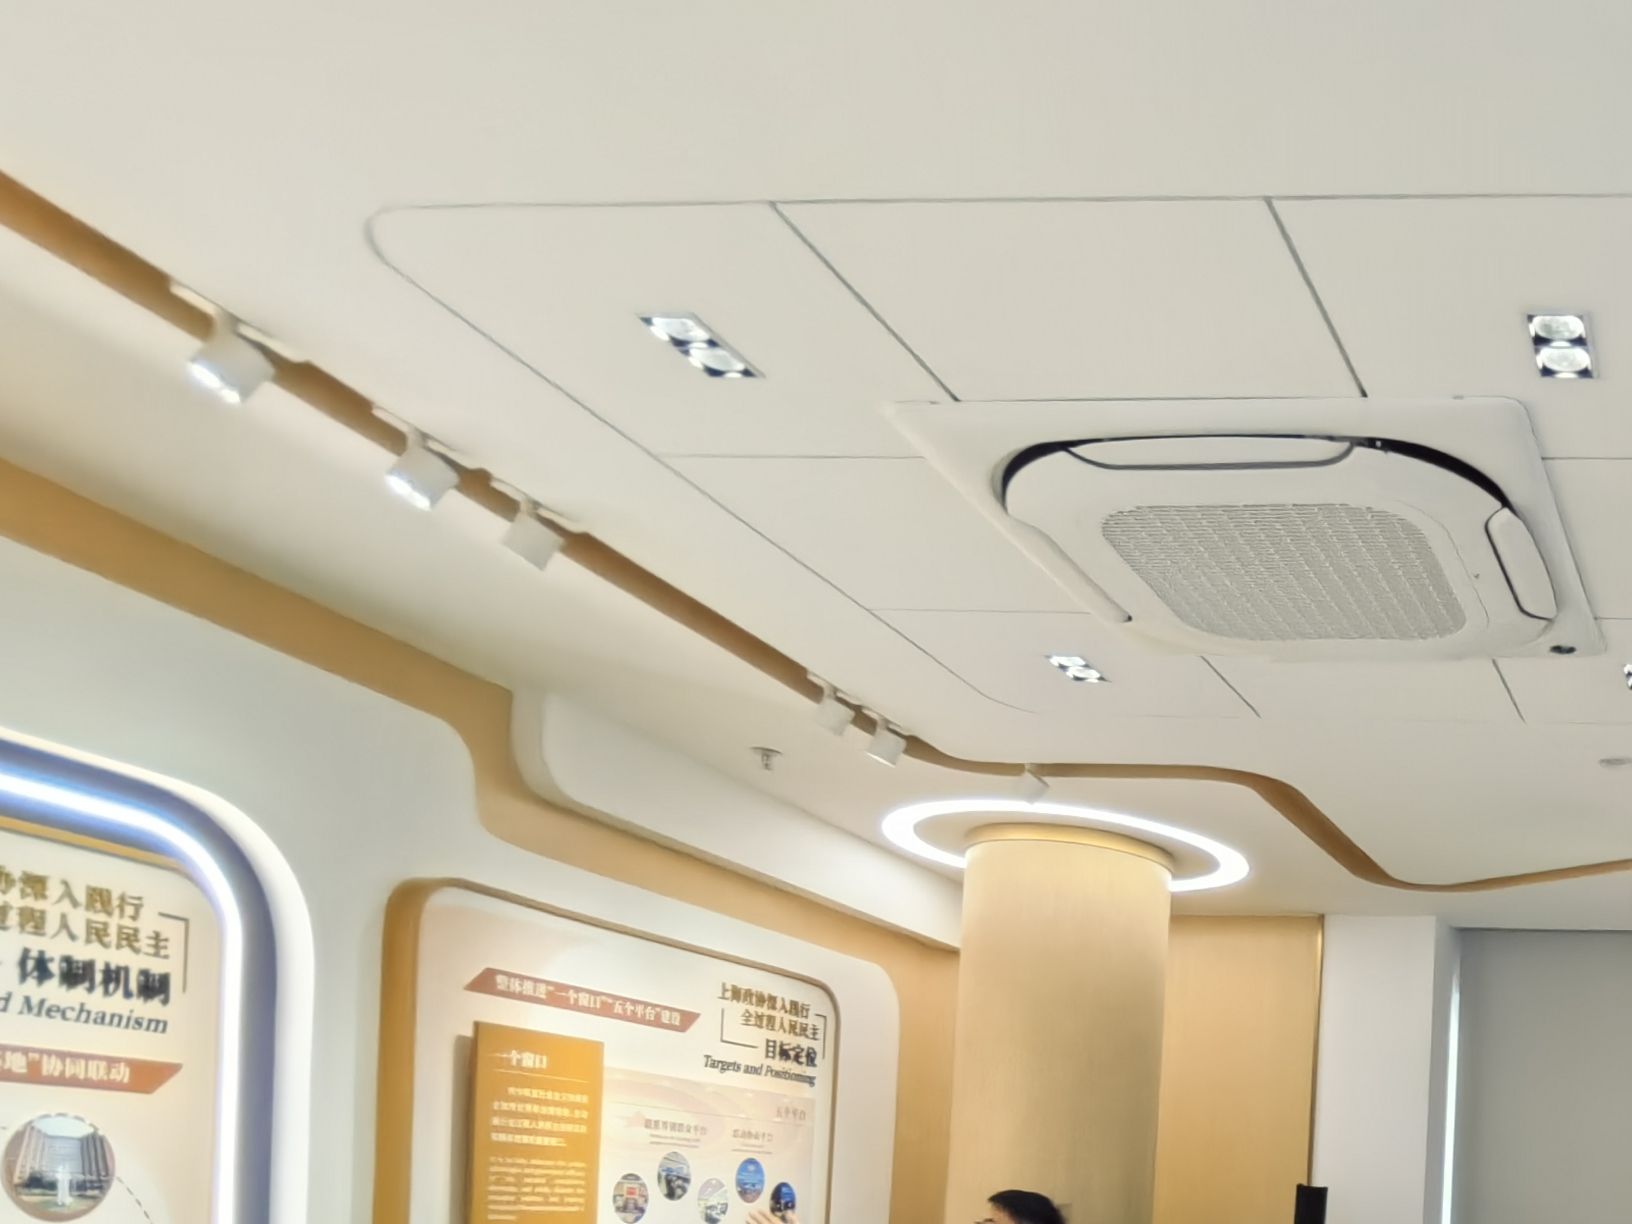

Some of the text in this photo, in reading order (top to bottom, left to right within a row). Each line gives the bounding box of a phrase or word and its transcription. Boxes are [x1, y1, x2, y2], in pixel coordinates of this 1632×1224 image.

[18, 947, 171, 1006] 体制机制
[17, 995, 169, 1034] Mechanism
[717, 981, 811, 1019] 上海政协深入践行
[740, 1008, 821, 1041] 全过程人民民主
[0, 1051, 131, 1083] 地”协同联动
[493, 1049, 547, 1069] 一个窗口
[765, 1038, 818, 1068] 目标定位
[703, 1055, 817, 1087] Targets and Positioning
